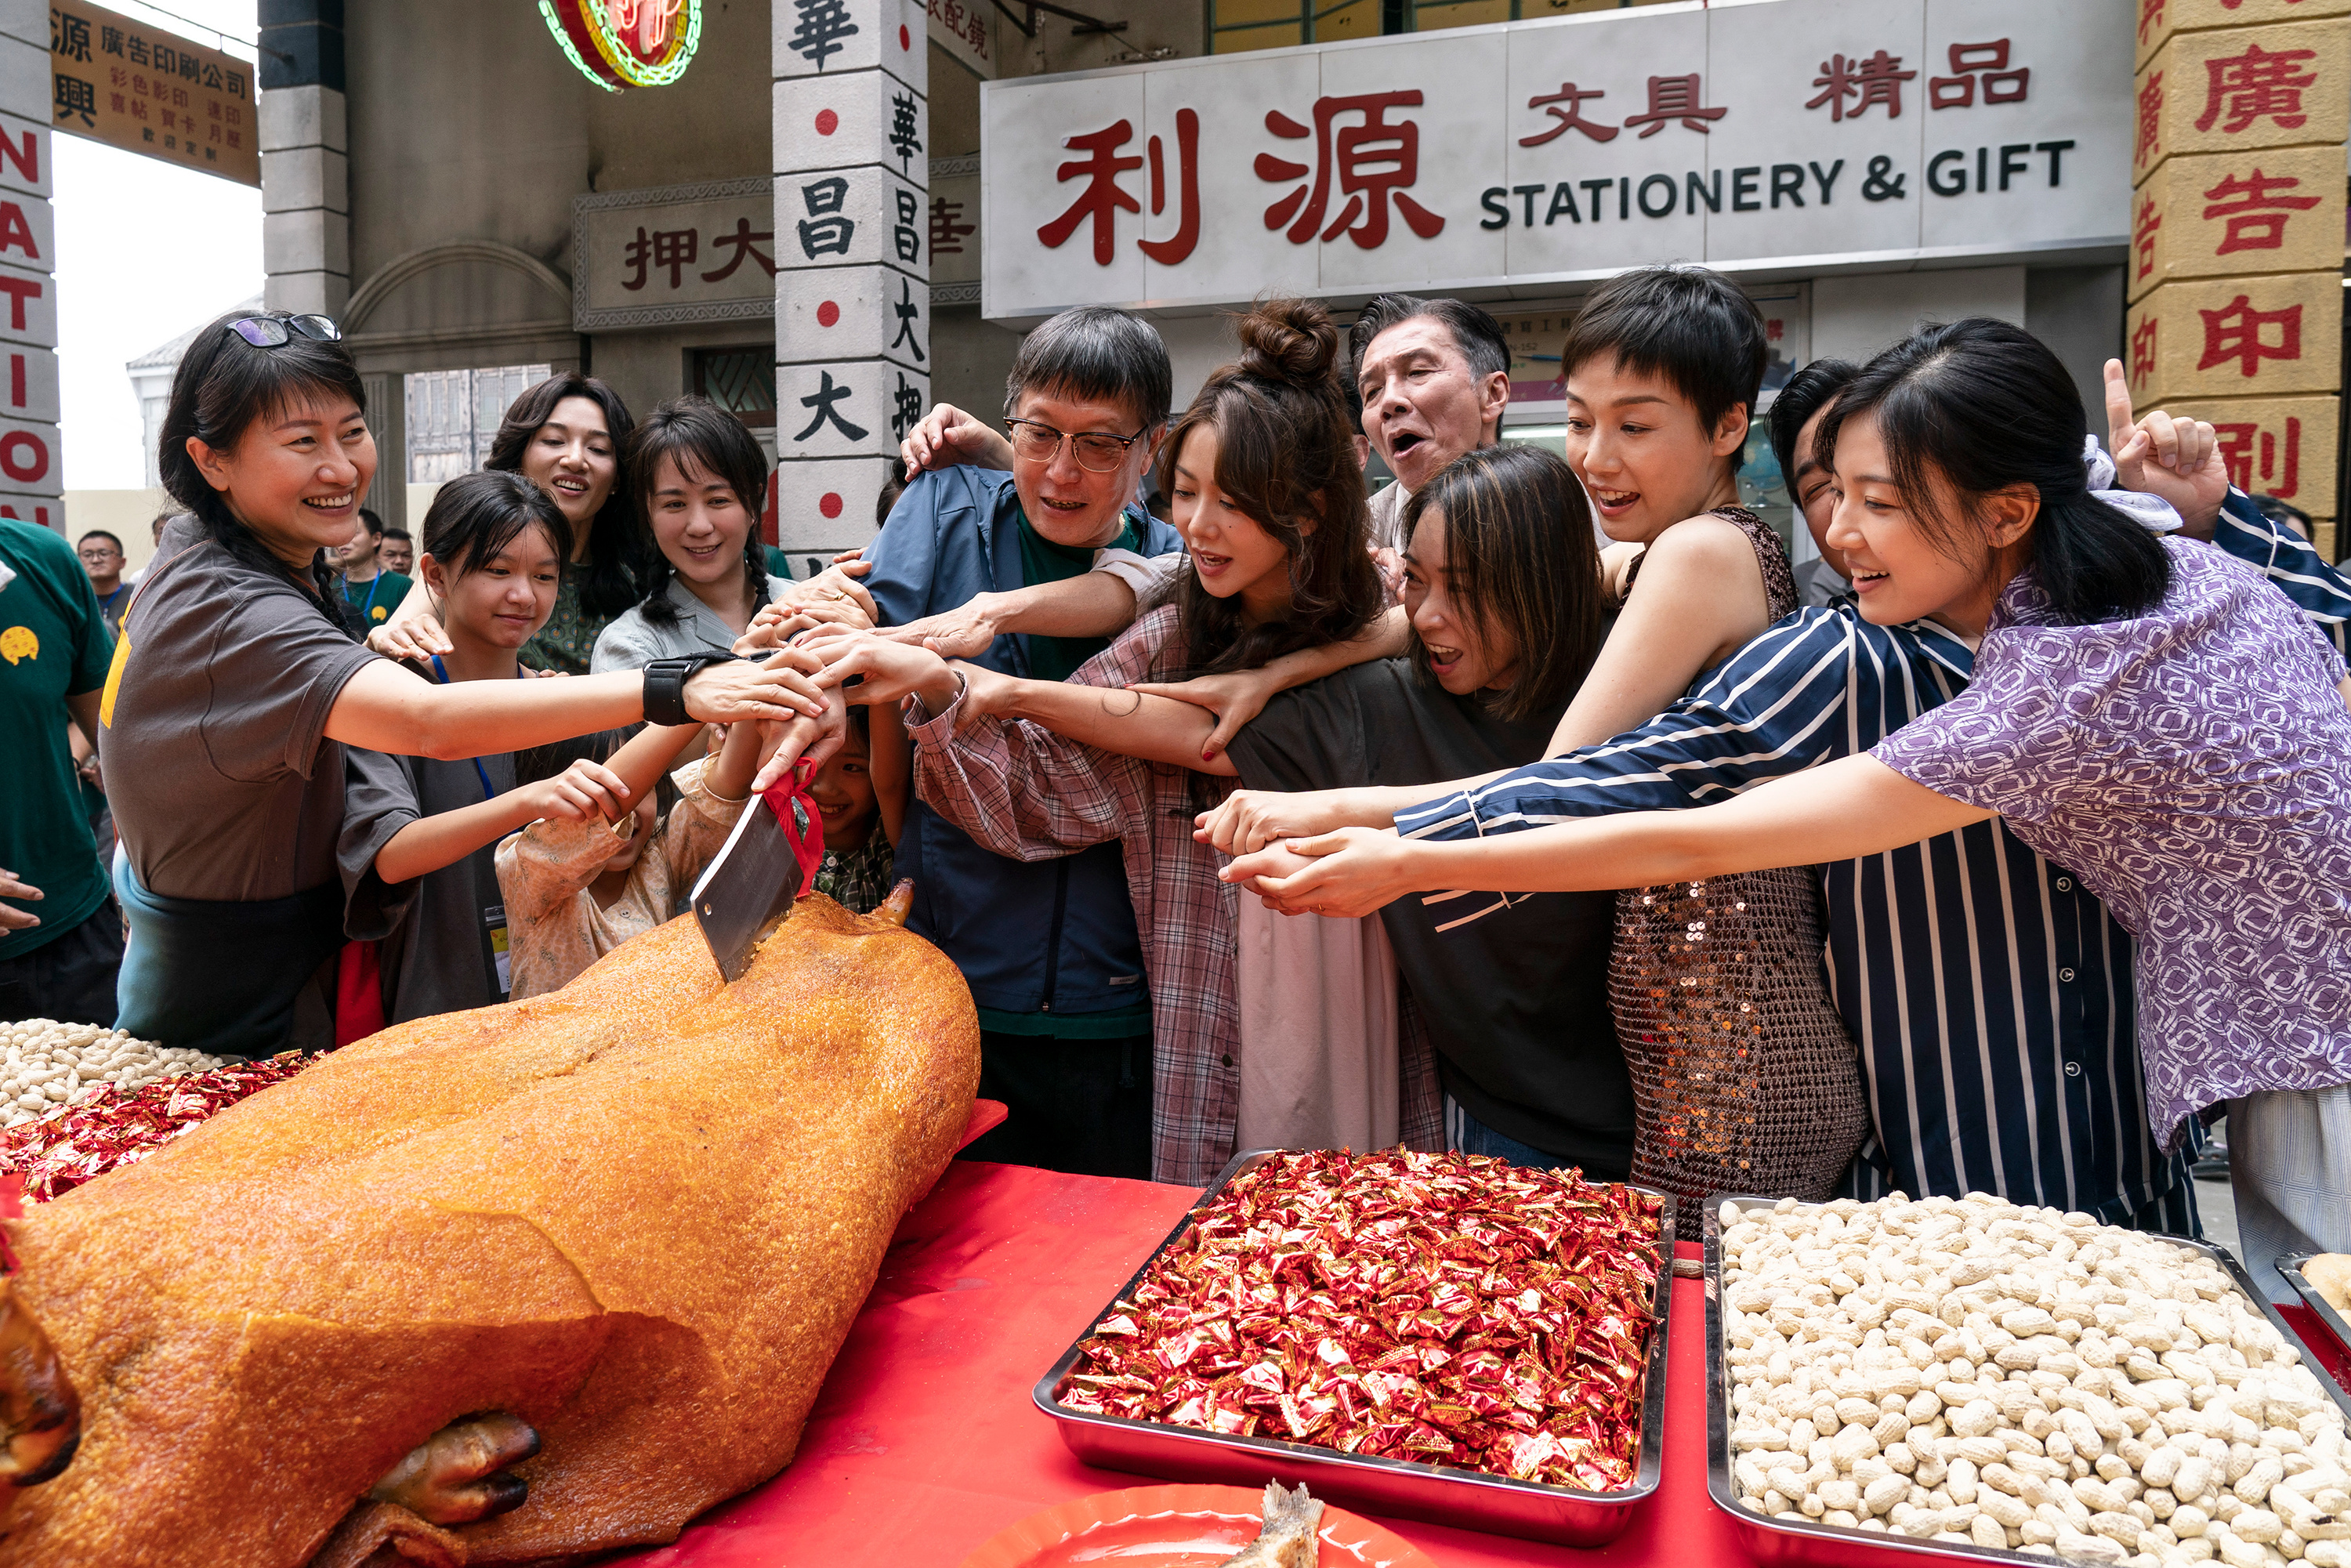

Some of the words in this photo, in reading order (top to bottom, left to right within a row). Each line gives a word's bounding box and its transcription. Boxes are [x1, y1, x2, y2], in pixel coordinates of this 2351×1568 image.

[51, 8, 96, 129] 源興
[101, 25, 246, 100] 廣告印刷公司
[110, 65, 189, 108] 彩色影印
[1519, 72, 1728, 147] 文具
[1805, 38, 2030, 122] 精品
[1037, 89, 1446, 266] 利源
[1480, 159, 1845, 230] STATIONERY
[1861, 154, 1906, 202] &
[1927, 139, 2076, 197] GIFT
[788, 0, 869, 579] 華昌大
[889, 90, 925, 448] 華昌大押
[2194, 0, 2323, 499] 廣告印刷
